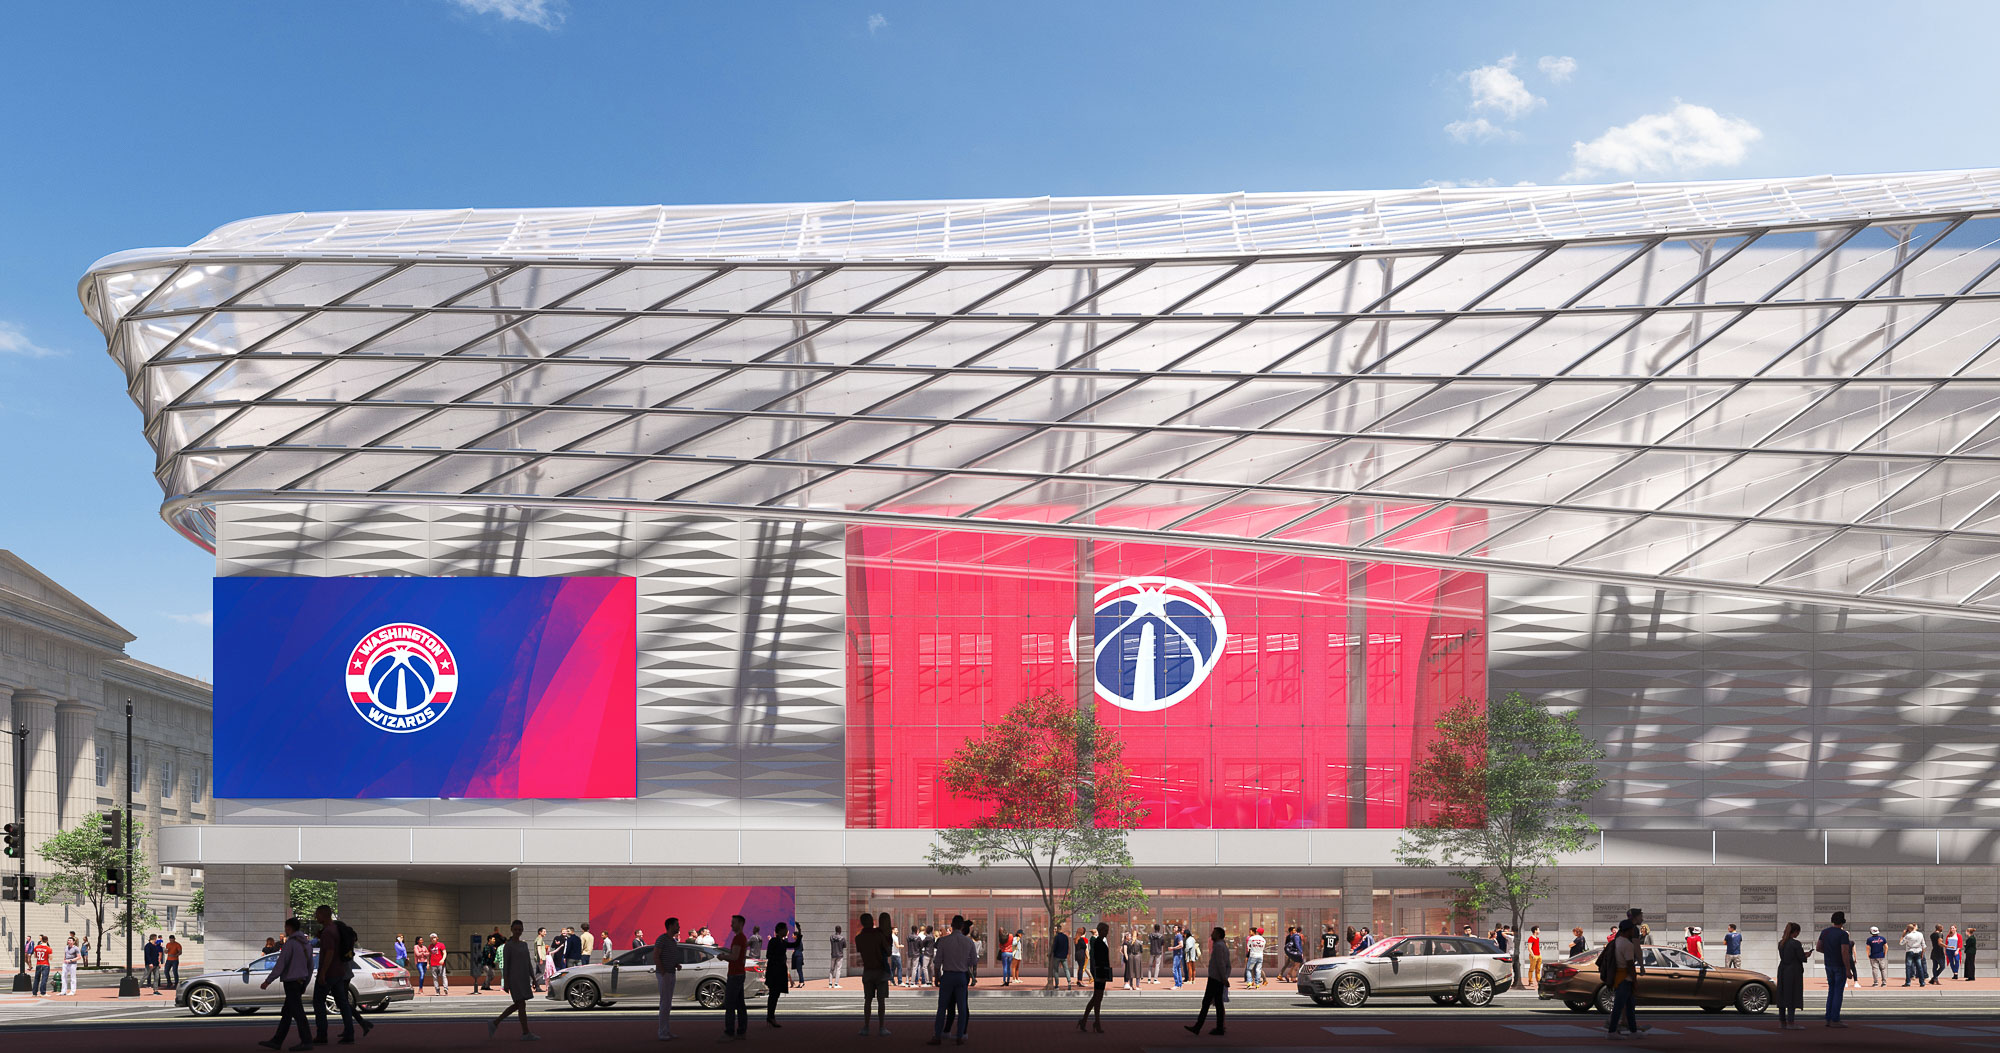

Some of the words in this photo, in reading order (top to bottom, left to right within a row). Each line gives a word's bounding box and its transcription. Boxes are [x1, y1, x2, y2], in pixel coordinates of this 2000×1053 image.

[358, 627, 444, 657] WASHINGTON
[368, 706, 436, 729] WIZARDS
[1327, 938, 1334, 948] 19
[37, 951, 45, 960] 92
